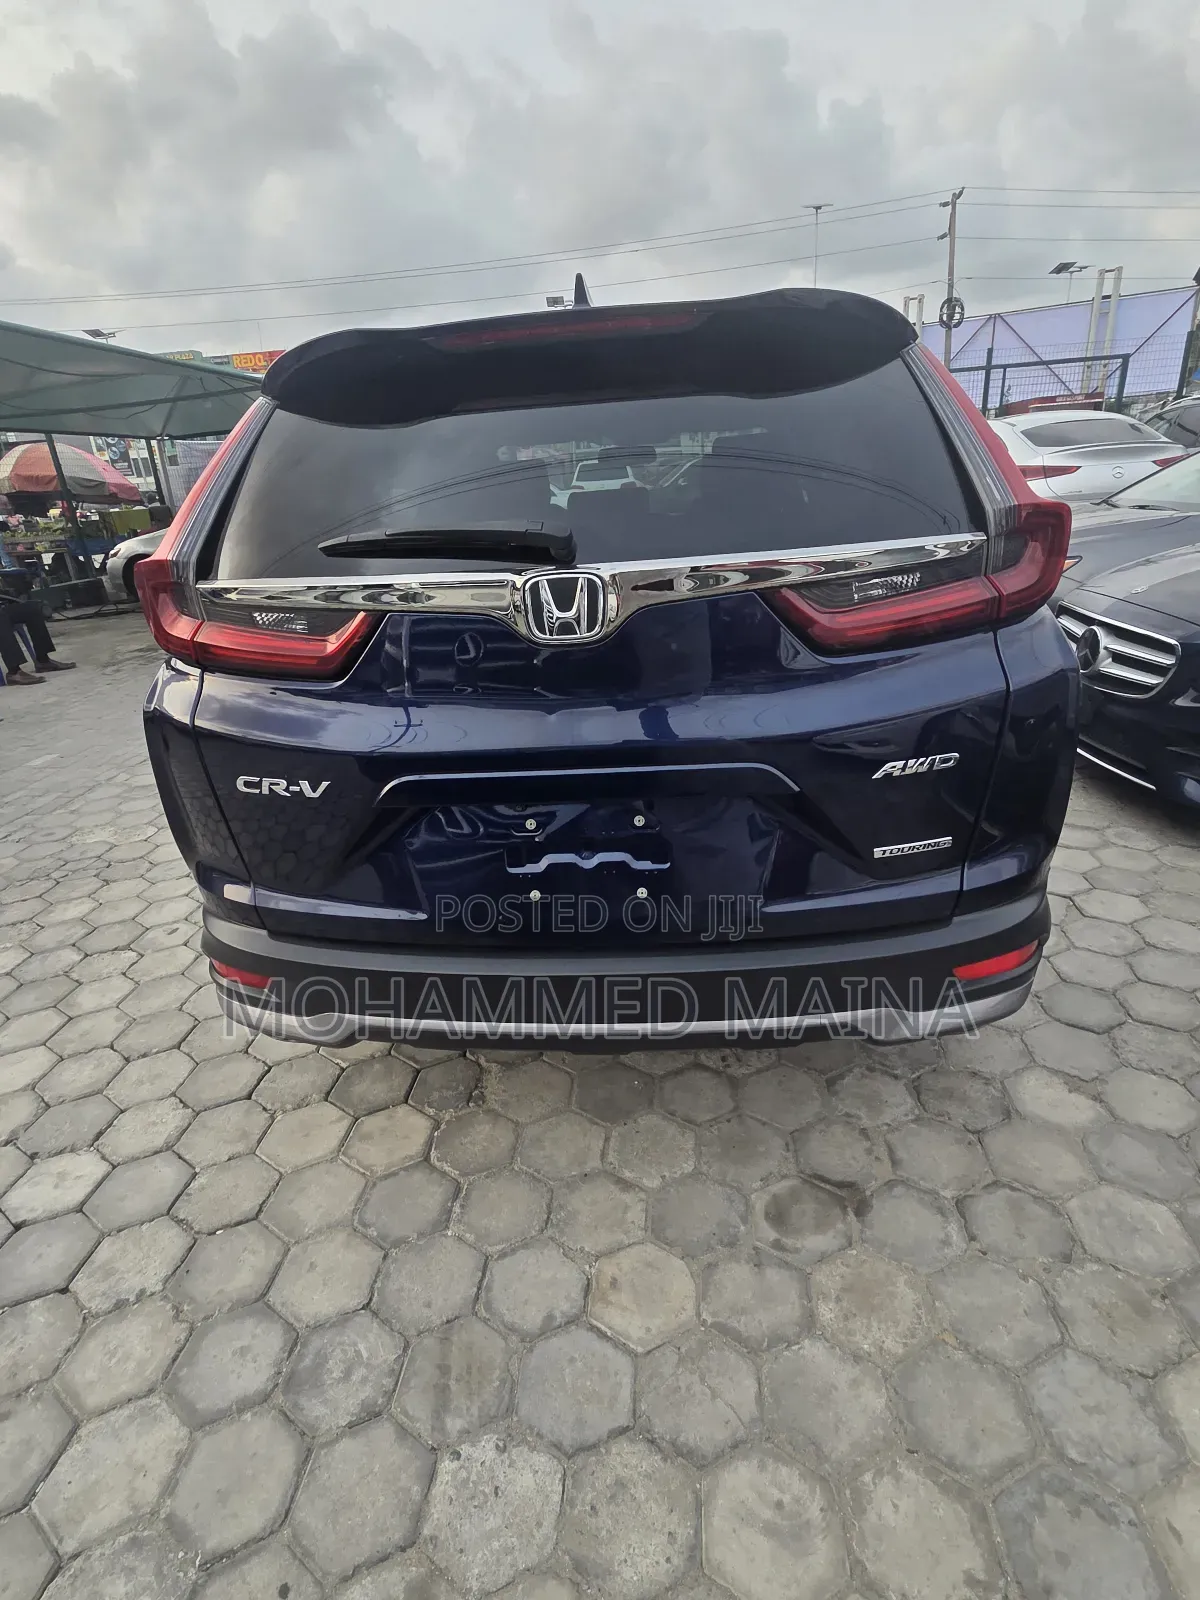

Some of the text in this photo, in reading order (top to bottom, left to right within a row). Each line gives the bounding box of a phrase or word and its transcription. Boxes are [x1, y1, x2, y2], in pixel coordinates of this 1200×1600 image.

[872, 753, 960, 779] AWD
[236, 775, 331, 798] CR-V
[881, 841, 948, 856] TOURING
